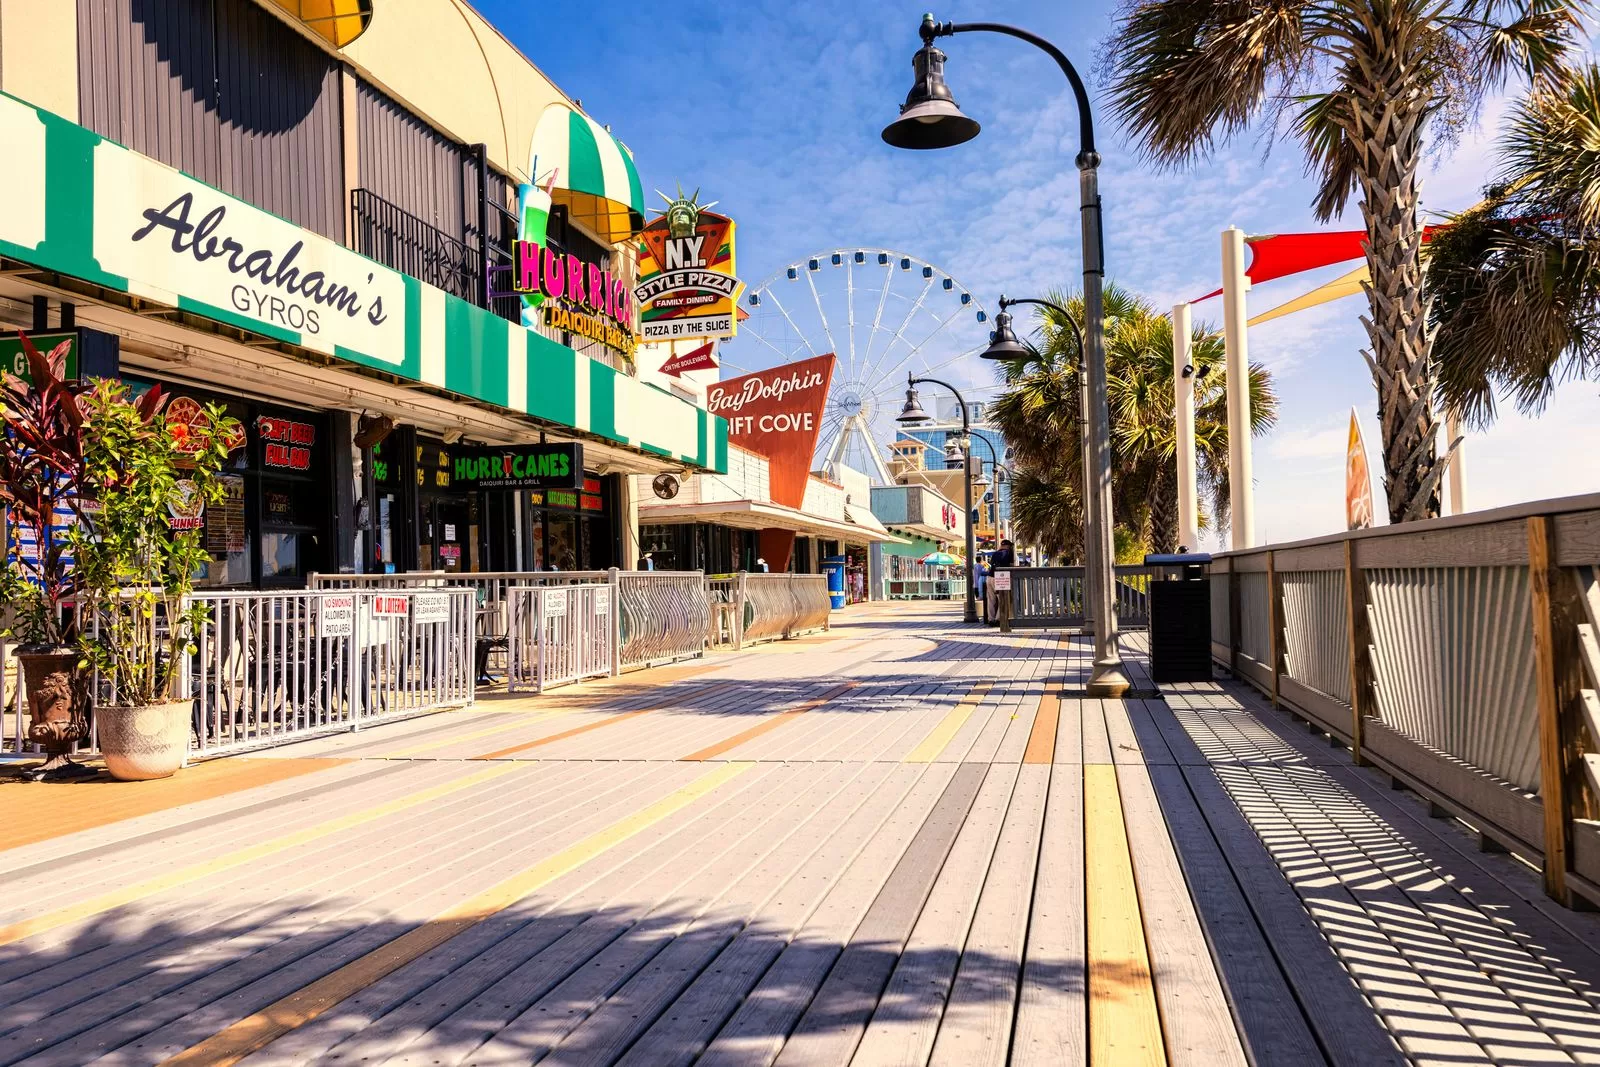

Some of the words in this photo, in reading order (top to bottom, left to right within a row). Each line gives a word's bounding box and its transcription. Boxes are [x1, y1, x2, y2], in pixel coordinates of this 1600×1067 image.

[131, 192, 388, 326] Abraham's
[665, 236, 706, 270] N.Y.
[636, 273, 684, 301] STYLE
[688, 273, 732, 293] PIZZA
[231, 284, 320, 334] GYROS
[656, 298, 684, 307] FAMILY
[686, 295, 714, 304] DINING
[551, 306, 605, 342] DAIQUIRI
[644, 325, 670, 337] PIZZA
[672, 324, 685, 335] BY
[687, 322, 703, 333] THE
[706, 319, 730, 332] SLICE
[664, 364, 671, 372] ON
[671, 361, 681, 370] THE
[680, 354, 708, 368] BOULEVARD
[727, 416, 754, 436] IFT
[759, 412, 813, 433] COVE
[265, 443, 289, 468] FULL
[289, 446, 311, 471] BAR
[168, 517, 205, 530] FUNNEL
[324, 599, 331, 608] NO
[331, 597, 352, 607] SMOKING
[375, 596, 383, 613] NO
[384, 596, 407, 614] LOITERING
[325, 610, 347, 620] ALLOWED
[346, 609, 351, 618] IN
[326, 624, 339, 633] PATIO
[339, 623, 351, 632] AREA
